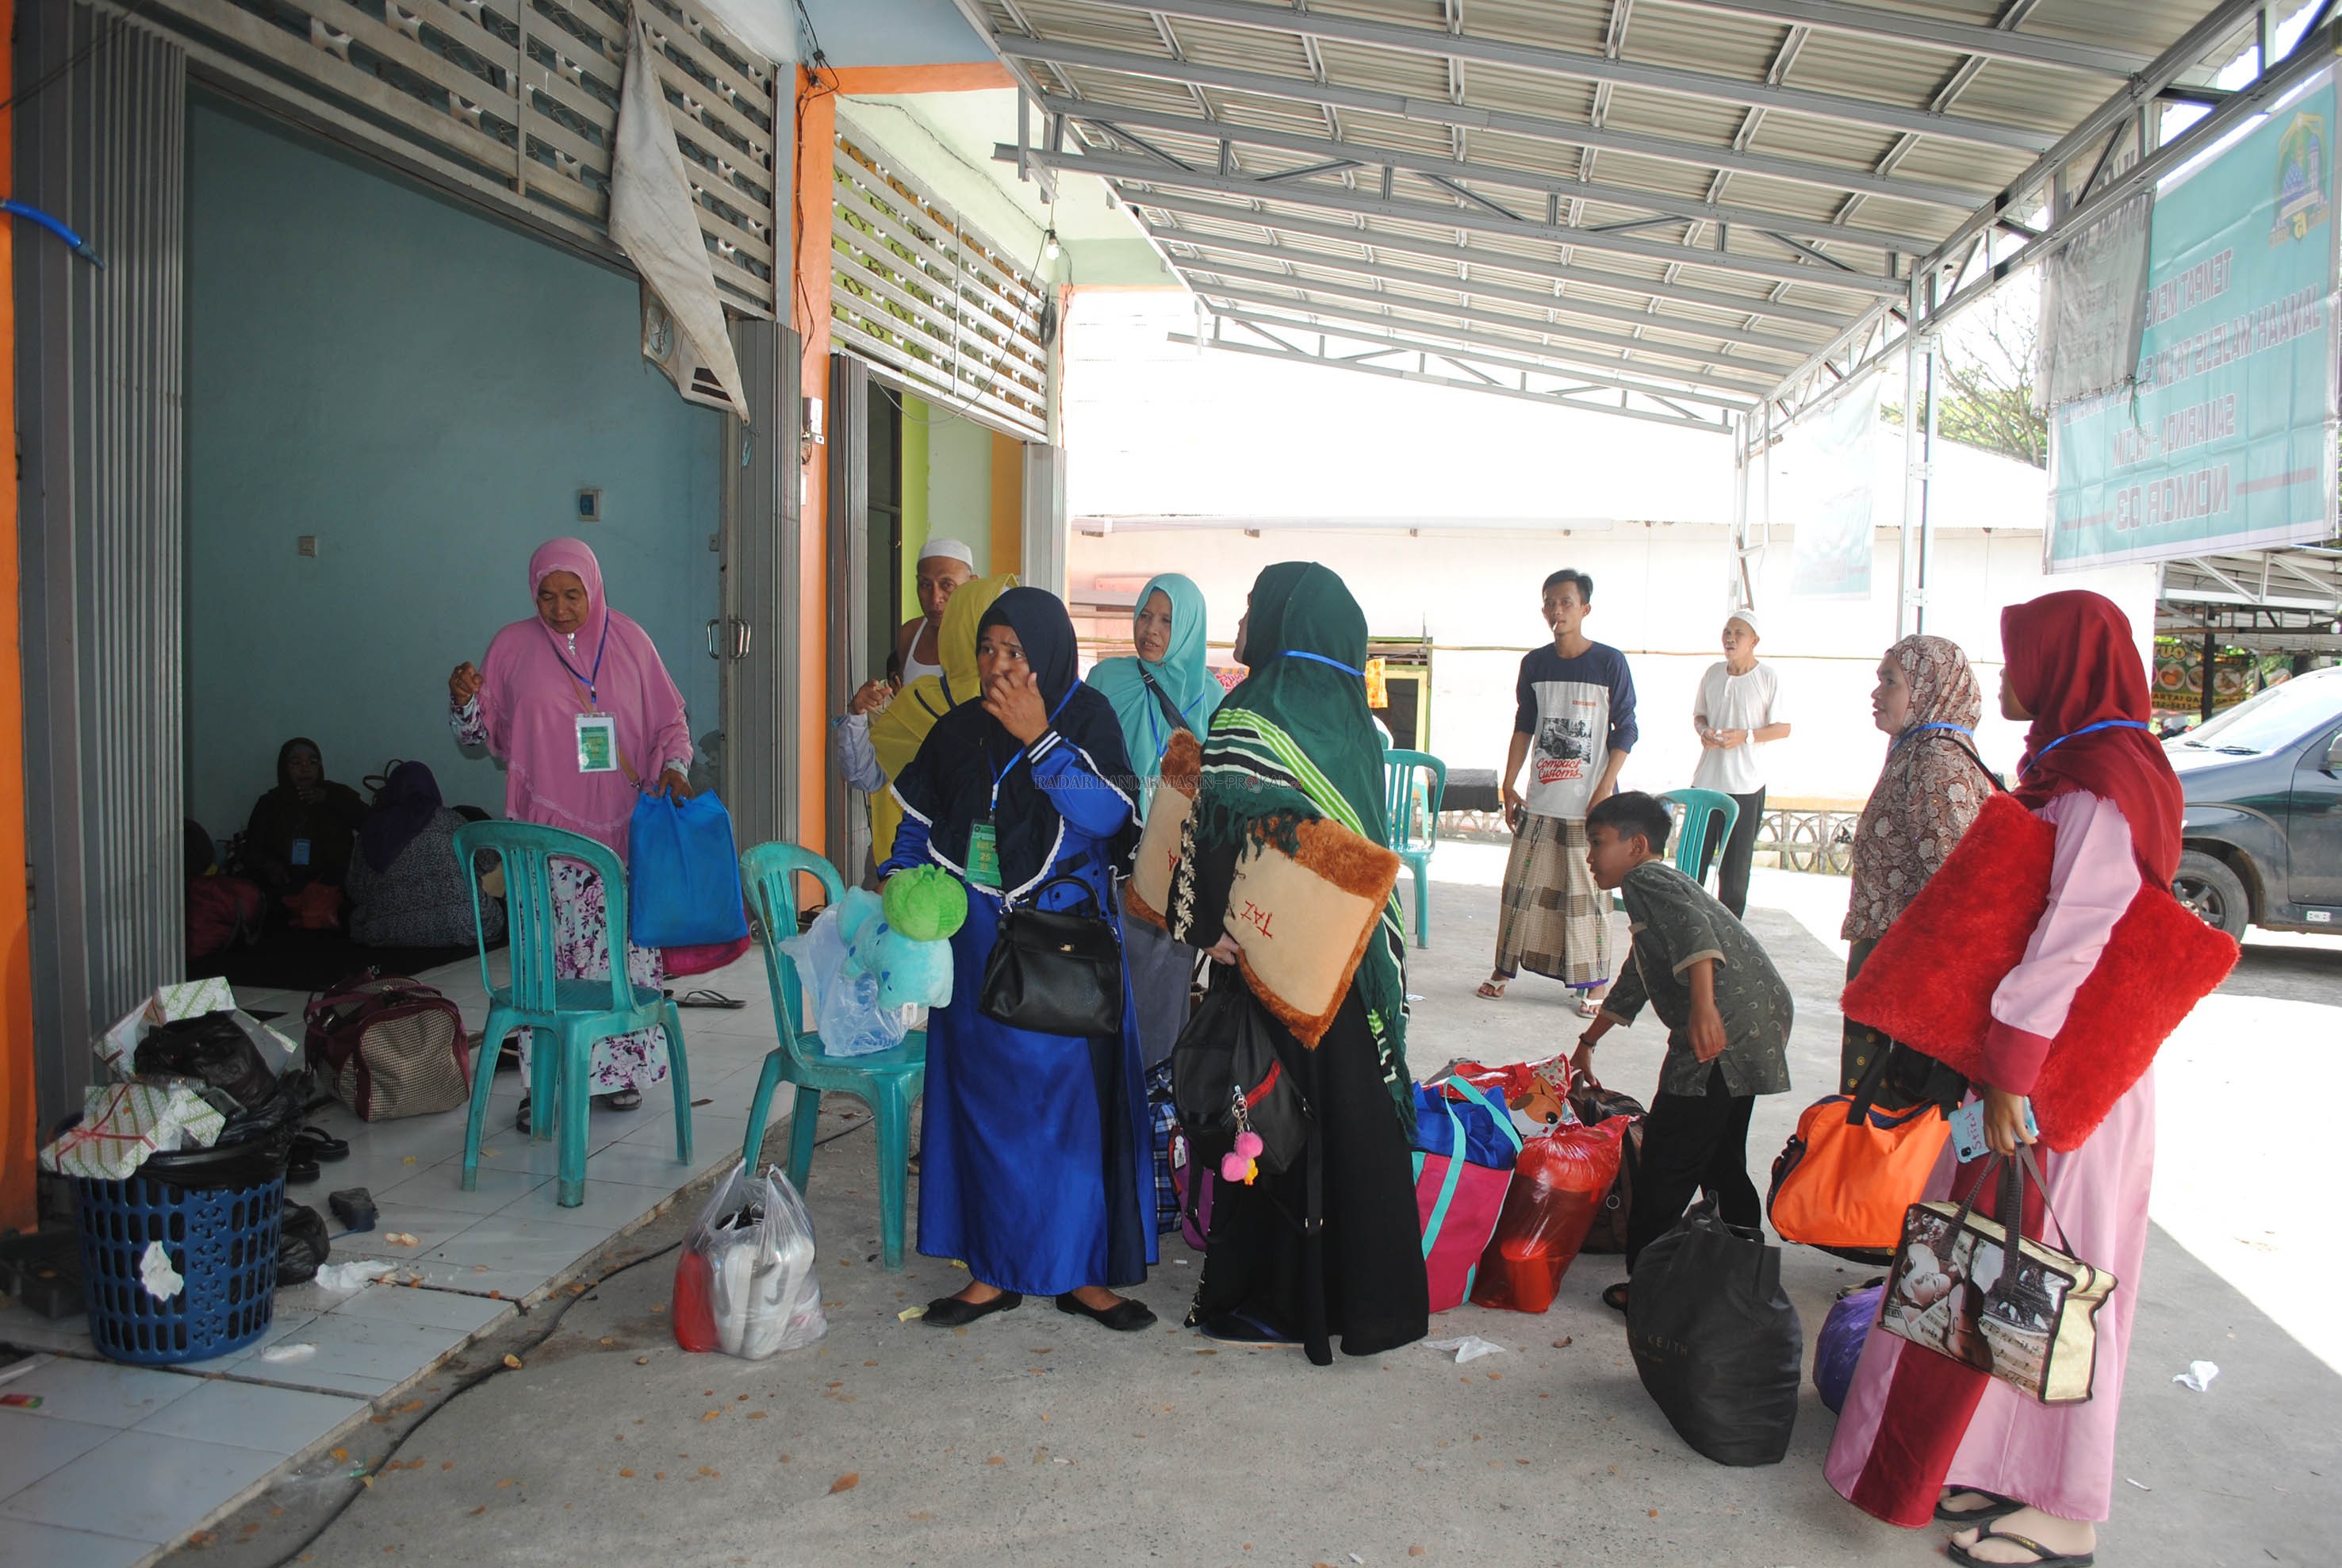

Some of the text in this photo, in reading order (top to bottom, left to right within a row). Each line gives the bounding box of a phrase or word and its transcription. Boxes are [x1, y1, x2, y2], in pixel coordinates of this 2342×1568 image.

[1536, 757, 1582, 769] Compact
[1538, 768, 1583, 780] Customs
[1647, 1333, 1688, 1357] KEITH
